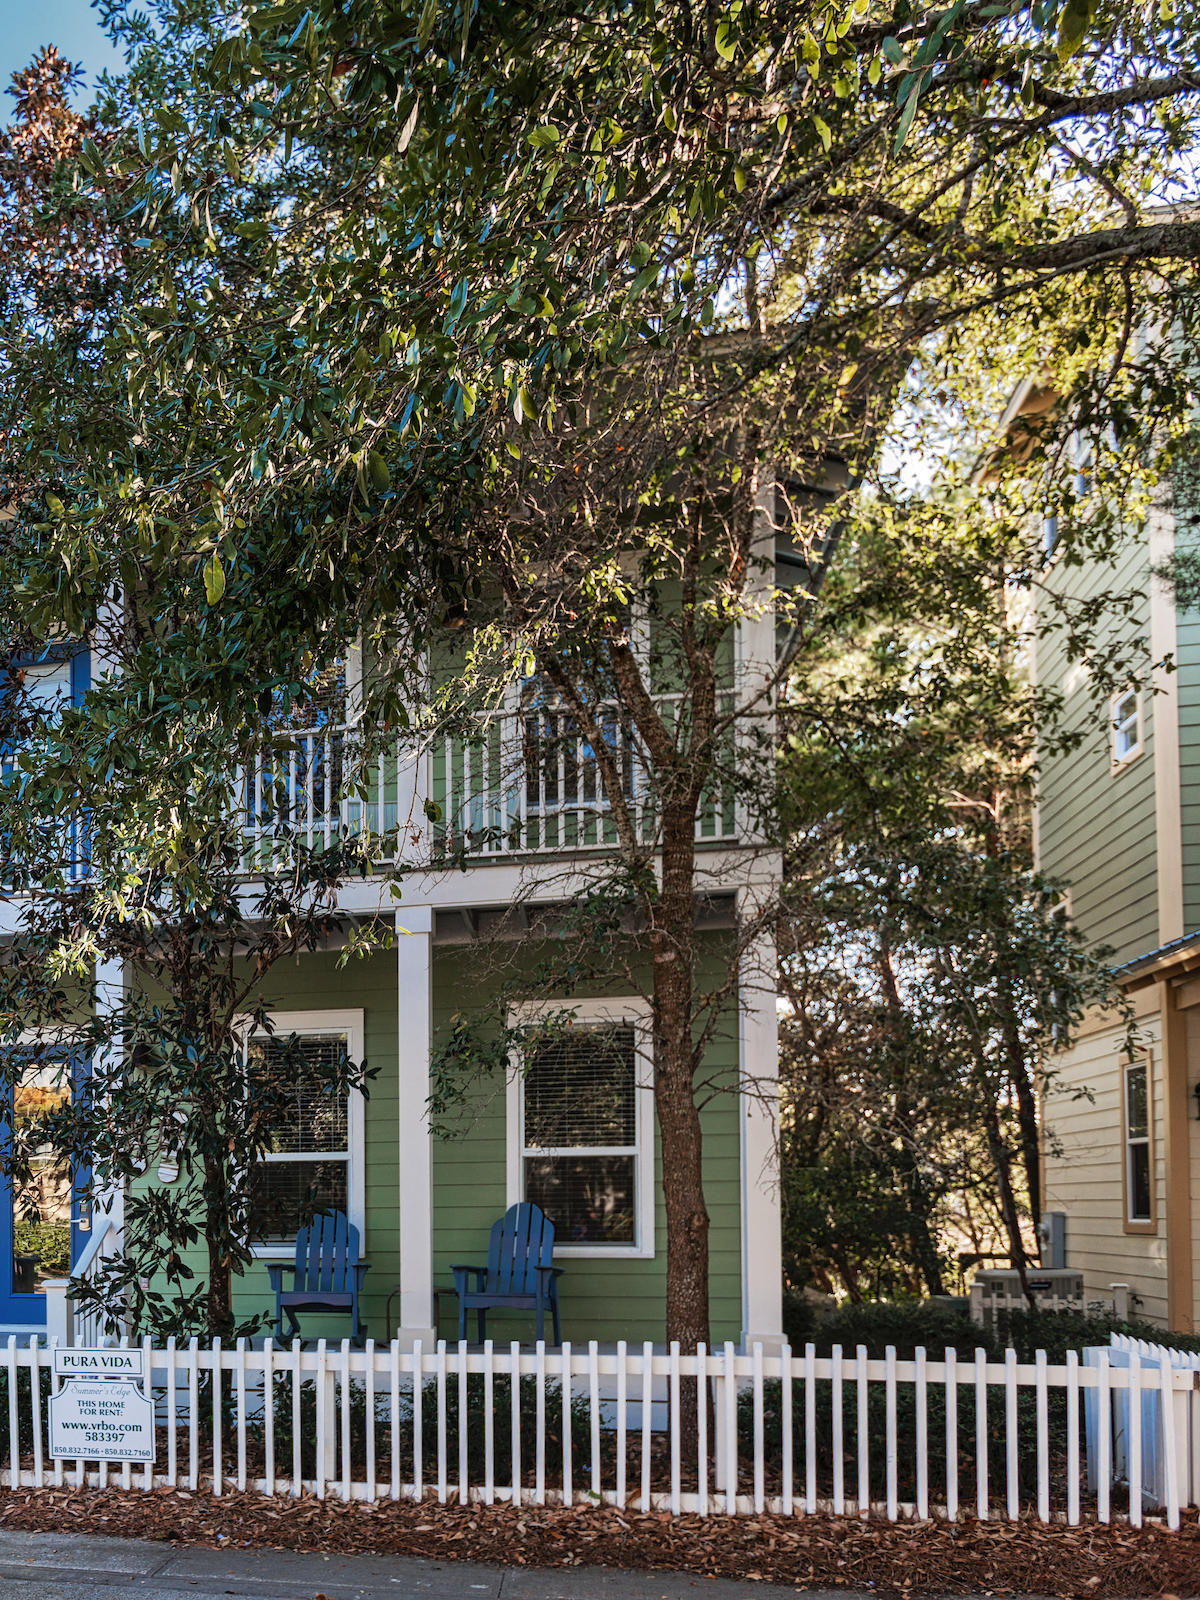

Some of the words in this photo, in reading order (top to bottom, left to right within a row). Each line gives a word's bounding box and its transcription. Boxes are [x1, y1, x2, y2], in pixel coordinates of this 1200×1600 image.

[63, 1356, 98, 1367] PURA
[101, 1357, 132, 1367] VIDA
[111, 1386, 131, 1399] Edge
[78, 1400, 96, 1408] THIS
[98, 1400, 125, 1408] HOME
[79, 1408, 97, 1416] FOR
[61, 1420, 142, 1432] www.vrbo.com
[85, 1432, 125, 1442] 583397
